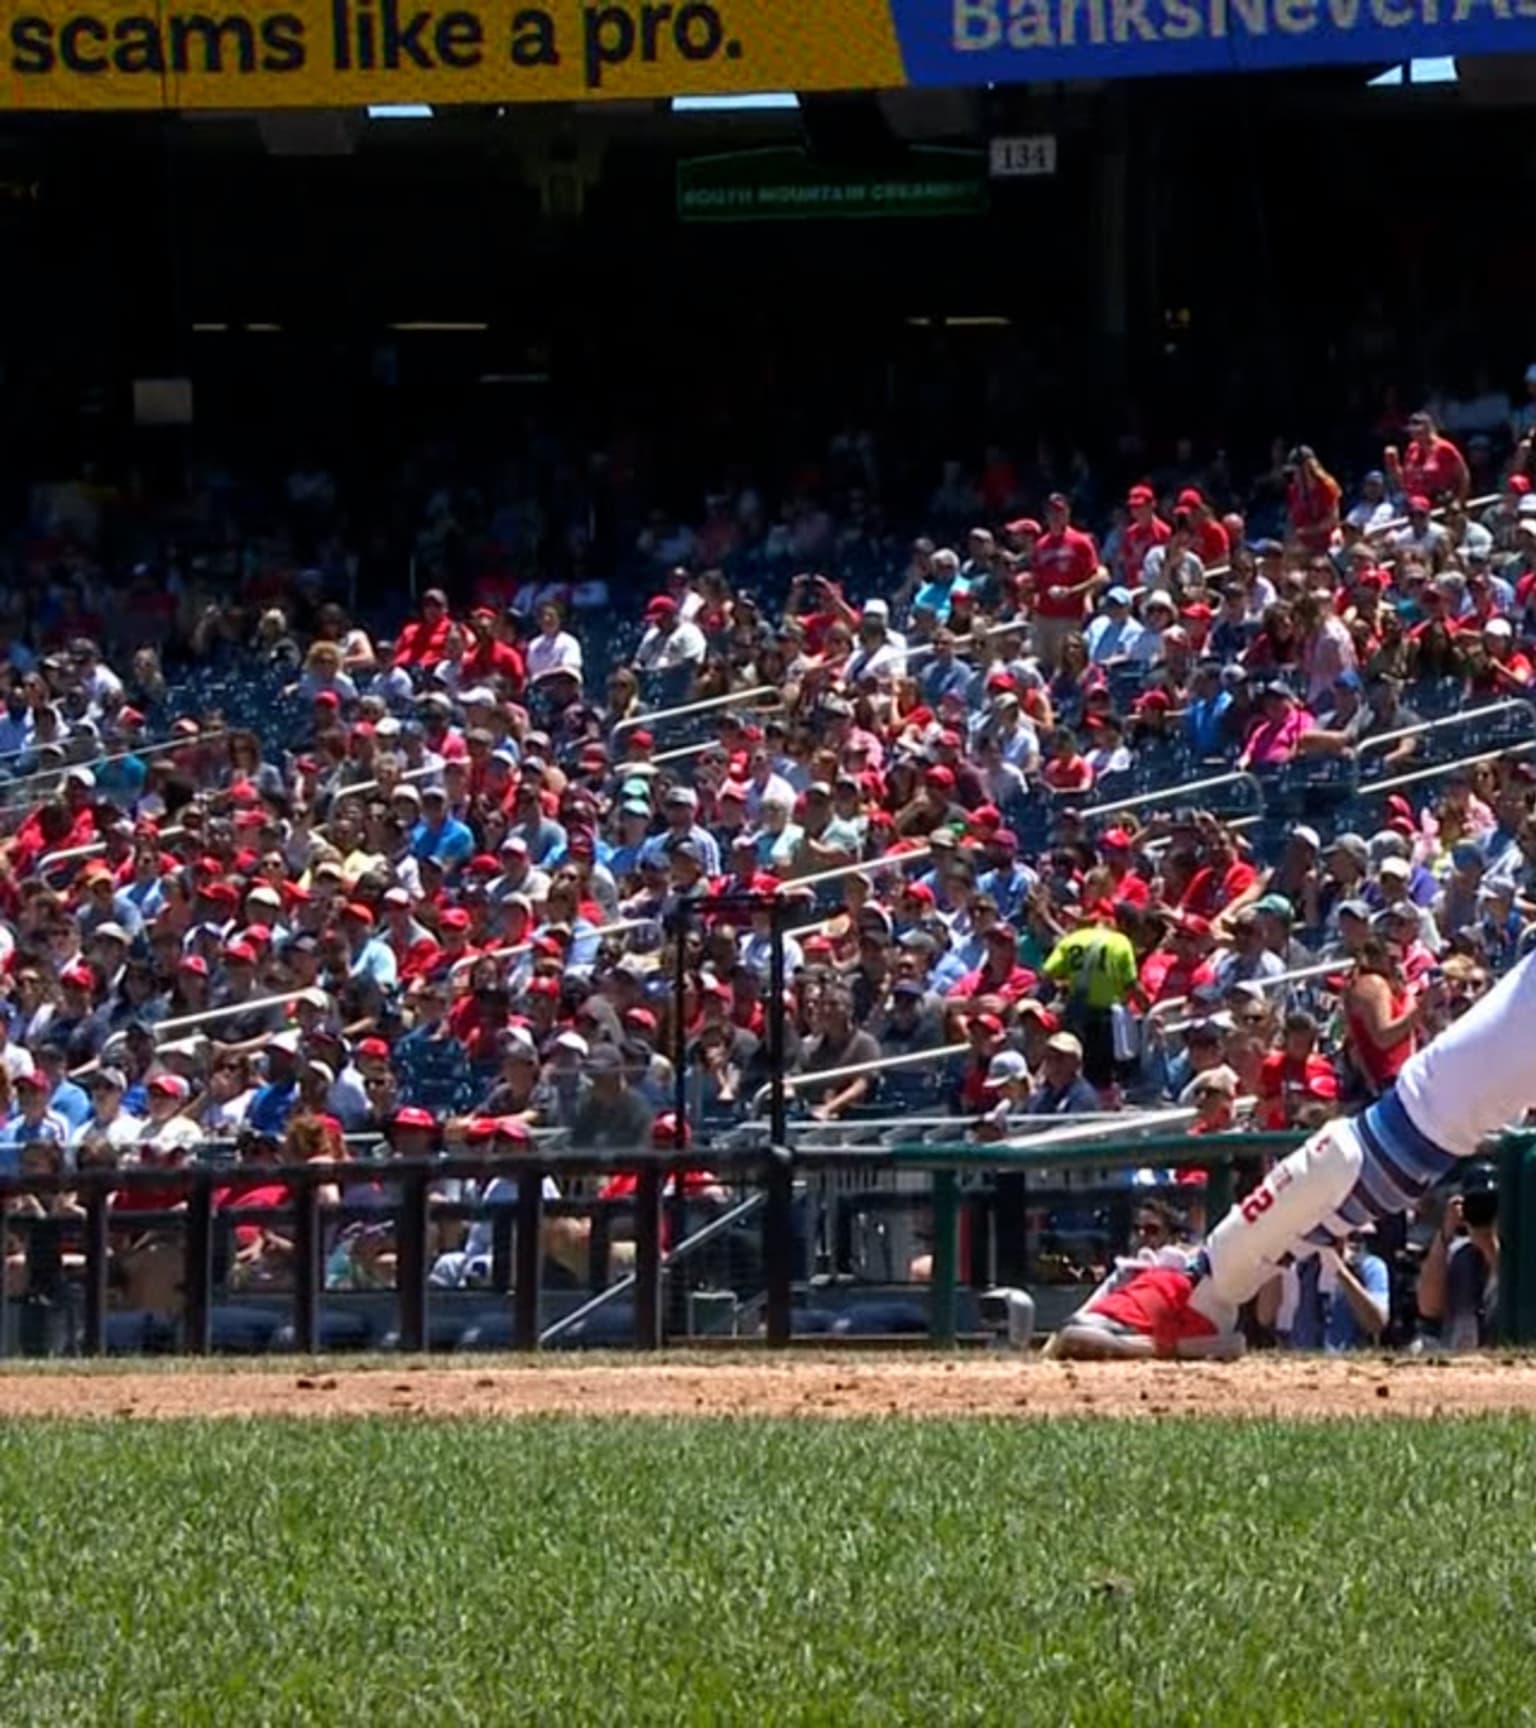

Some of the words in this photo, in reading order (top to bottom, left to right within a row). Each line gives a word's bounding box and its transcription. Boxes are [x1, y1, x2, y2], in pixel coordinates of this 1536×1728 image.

[10, 13, 306, 74] scams
[333, 0, 483, 70] like
[511, 8, 559, 67] a
[582, 0, 743, 88] pro.
[1003, 143, 1047, 169] 134
